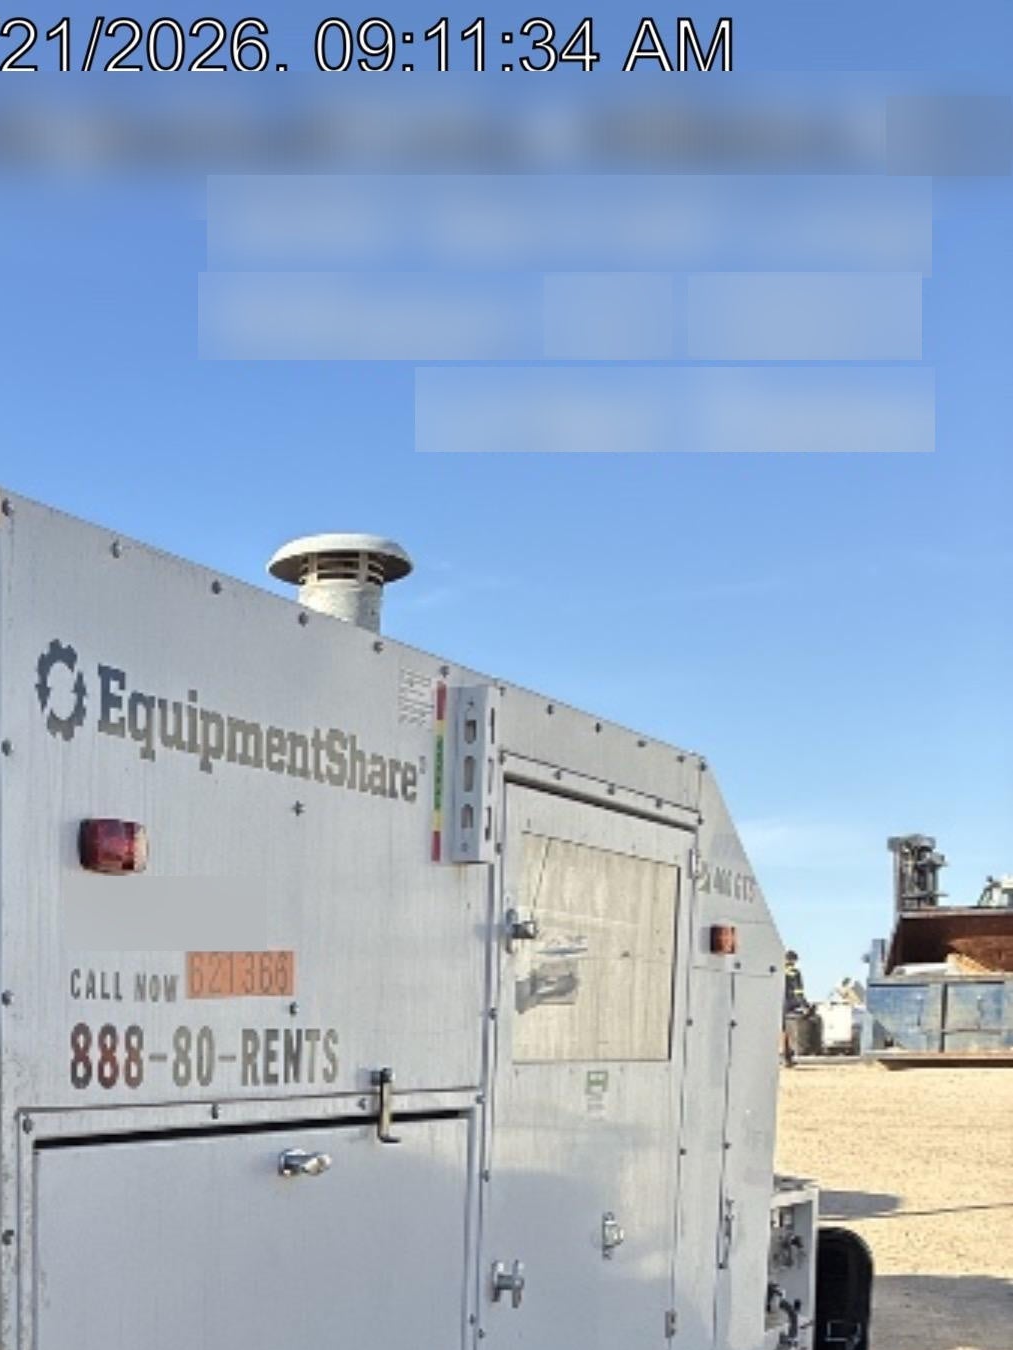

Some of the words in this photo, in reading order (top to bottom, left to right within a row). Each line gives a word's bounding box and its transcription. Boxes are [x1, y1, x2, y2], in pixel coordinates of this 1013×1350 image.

[97, 663, 418, 803] EquipmentShare
[70, 968, 123, 1001] CALL
[134, 973, 179, 1002] NOW
[70, 1022, 340, 1089] 888-80-RENTS
